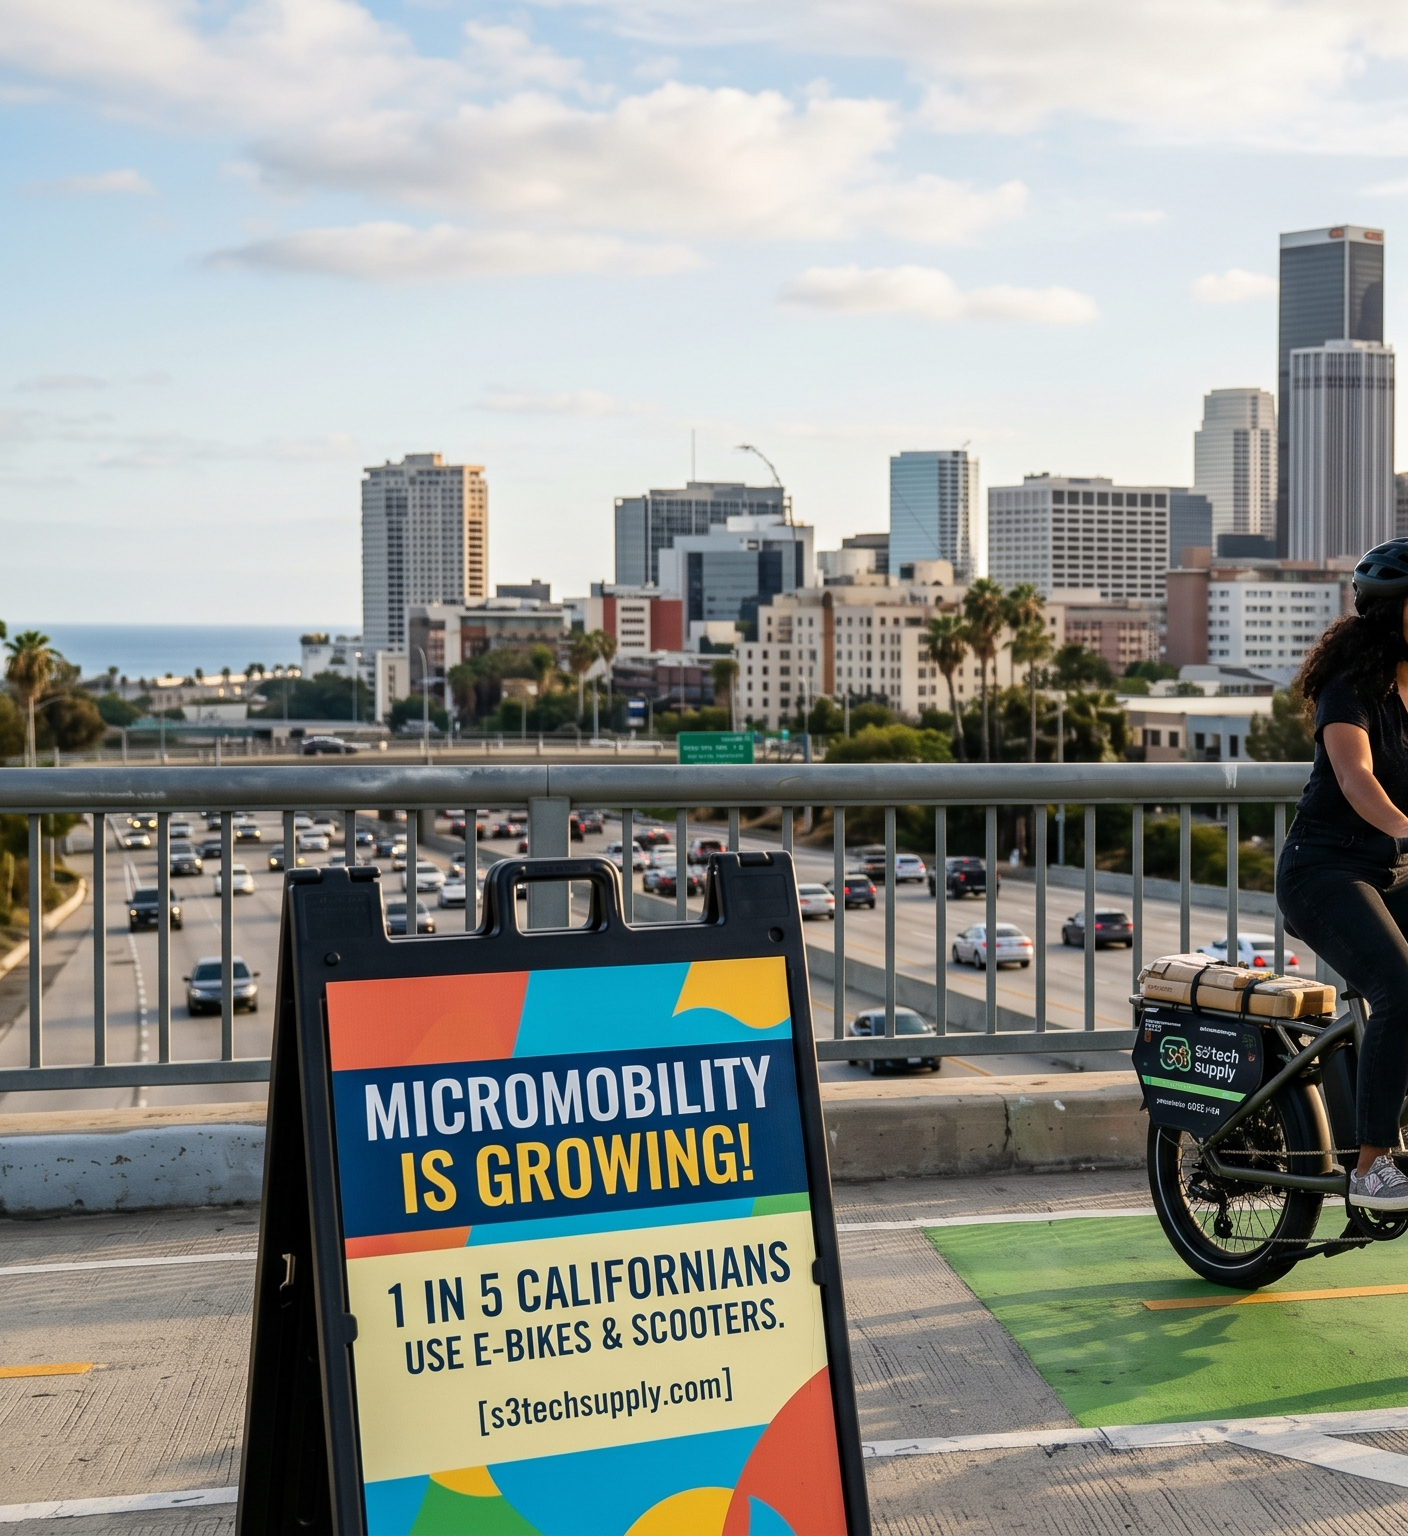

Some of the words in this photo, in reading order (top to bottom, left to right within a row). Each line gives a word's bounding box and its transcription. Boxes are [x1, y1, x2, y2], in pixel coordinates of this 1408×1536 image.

[365, 1055, 771, 1141] MICROMOBILITY
[1194, 1061, 1236, 1083] supply
[401, 1149, 457, 1214] IS
[476, 1122, 754, 1207] GROWING!
[387, 1282, 405, 1328] 1
[424, 1276, 465, 1325] IN
[480, 1272, 503, 1318] 5
[516, 1240, 791, 1313] CALIFORNIANS
[405, 1335, 465, 1375] USE
[473, 1320, 592, 1367] E-BIKES
[602, 1316, 623, 1350] &
[631, 1297, 785, 1347] SCOOTERS.
[478, 1366, 733, 1437] [s3techsupply.com]
